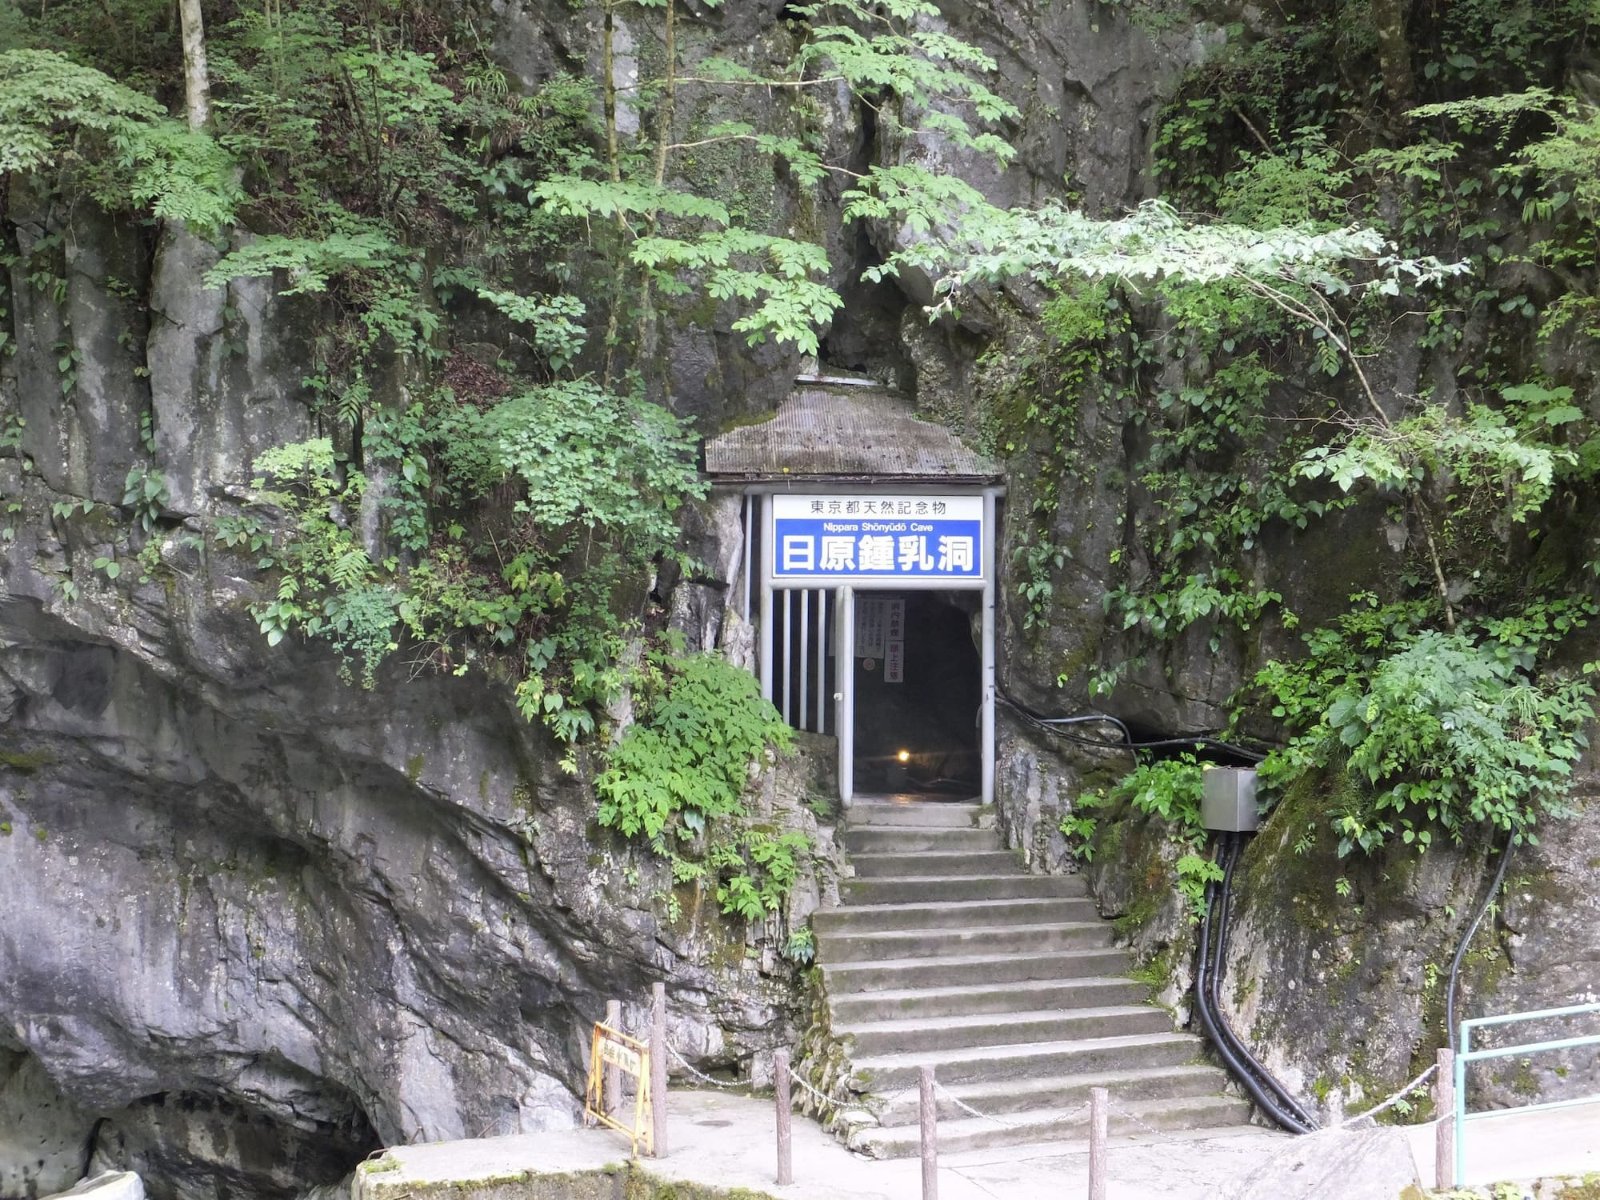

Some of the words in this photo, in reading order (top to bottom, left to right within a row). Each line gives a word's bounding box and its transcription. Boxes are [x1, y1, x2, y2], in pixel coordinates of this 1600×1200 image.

[810, 500, 947, 515] 東京都天然記念物
[823, 522, 859, 533] Nippara
[910, 522, 934, 532] Cave
[783, 534, 974, 572] 日原鍾乳洞
